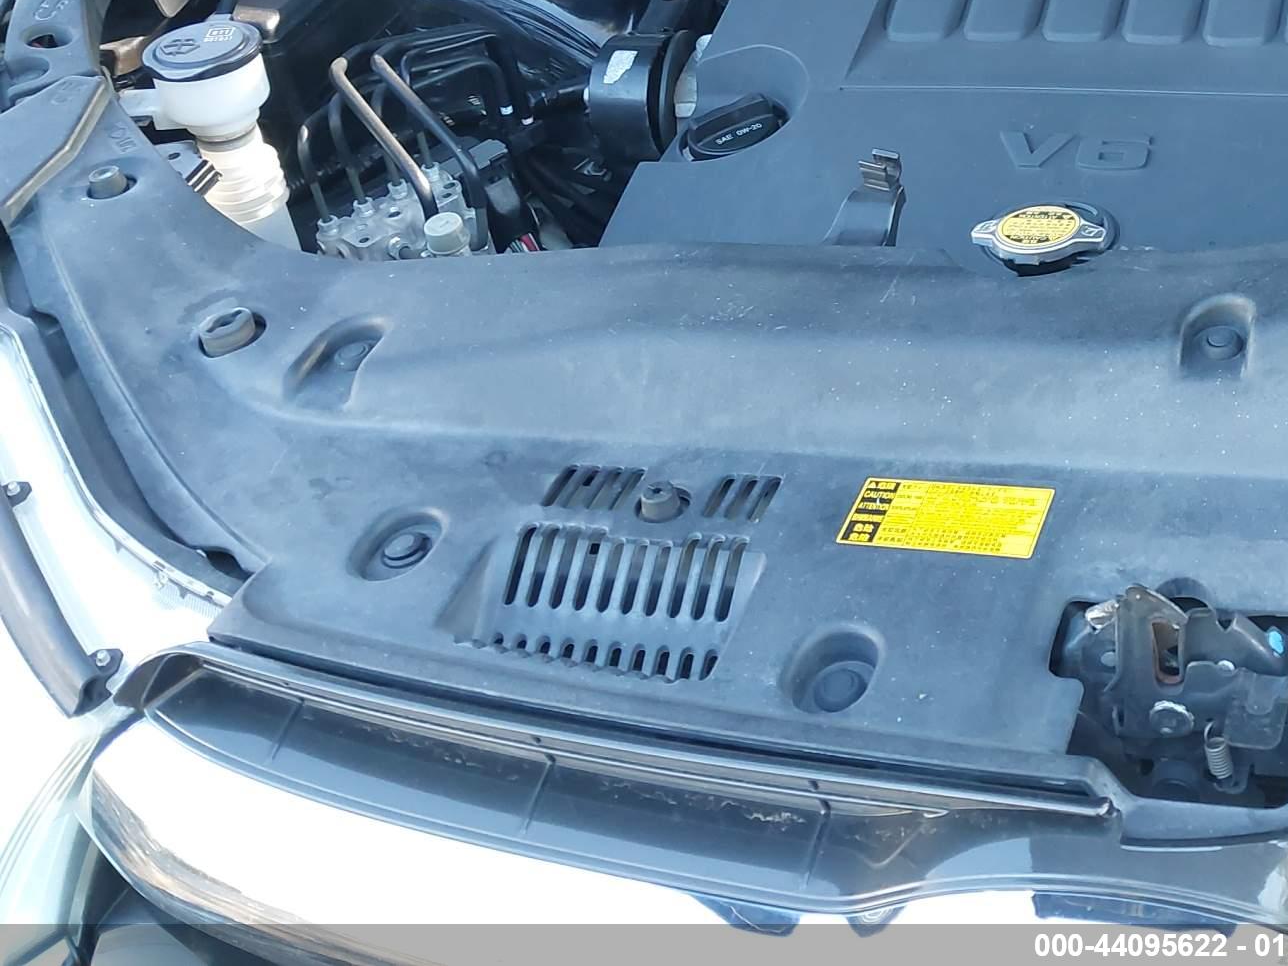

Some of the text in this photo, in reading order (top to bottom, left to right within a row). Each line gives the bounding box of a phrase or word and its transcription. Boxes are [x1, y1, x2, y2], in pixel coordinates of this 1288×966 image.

[715, 123, 763, 145] SAE 0W-20
[1000, 131, 1153, 171] V6
[863, 490, 897, 500] CAUTION
